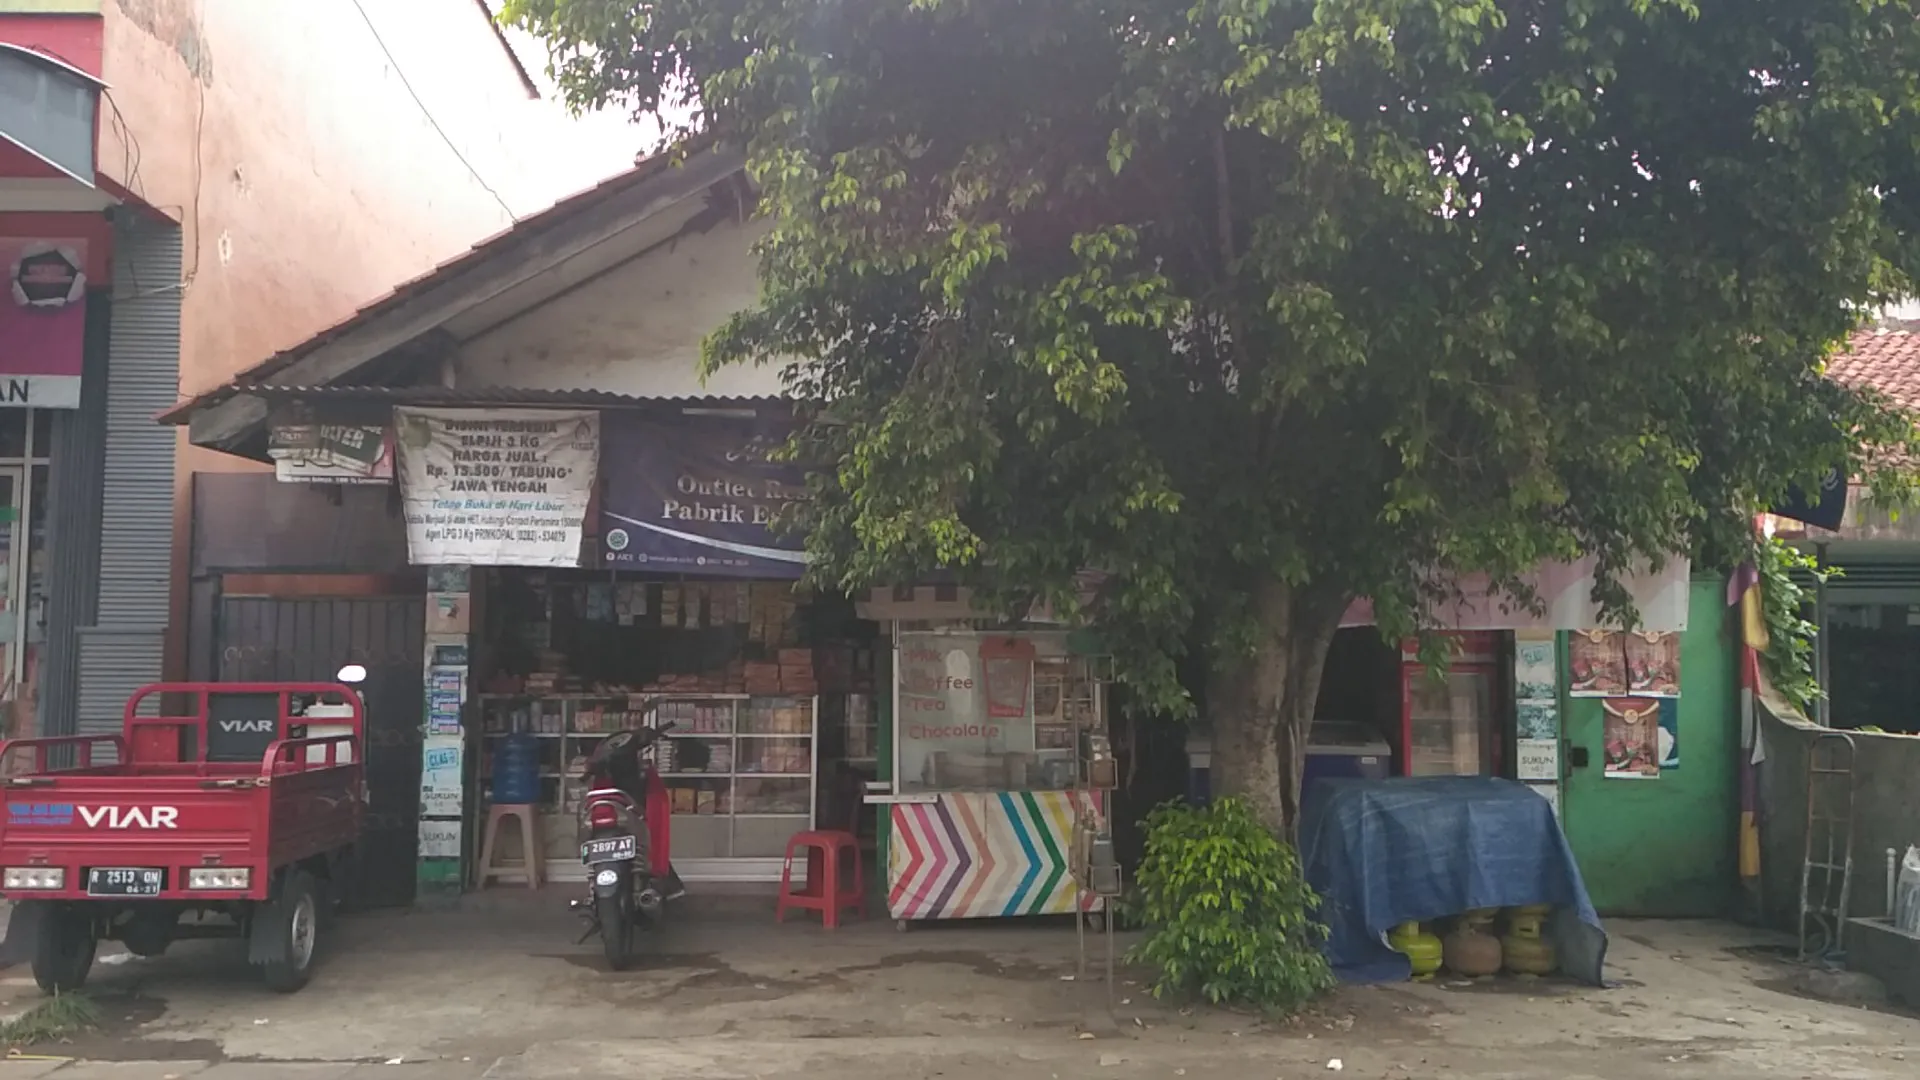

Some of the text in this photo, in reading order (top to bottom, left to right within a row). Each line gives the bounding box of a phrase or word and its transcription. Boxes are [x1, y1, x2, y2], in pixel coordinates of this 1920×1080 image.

[507, 436, 515, 448] 3
[519, 436, 540, 448] KG
[452, 450, 501, 462] HARGA
[505, 451, 538, 463] JUAL
[426, 465, 448, 479] Rp.
[450, 480, 547, 493] JAWA TENGAH
[464, 499, 493, 509] Buka
[509, 501, 532, 511] Hari
[535, 502, 565, 511] Libur
[661, 499, 745, 523] Pabrik
[442, 528, 457, 540] LPG
[464, 529, 474, 543] Kg
[913, 675, 974, 690] Coffee
[913, 699, 946, 712] Tea
[219, 720, 274, 733] VIAR
[909, 723, 999, 740] Chocolate
[77, 805, 179, 829] VIAR
[92, 870, 99, 883] R
[107, 870, 135, 884] 2513
